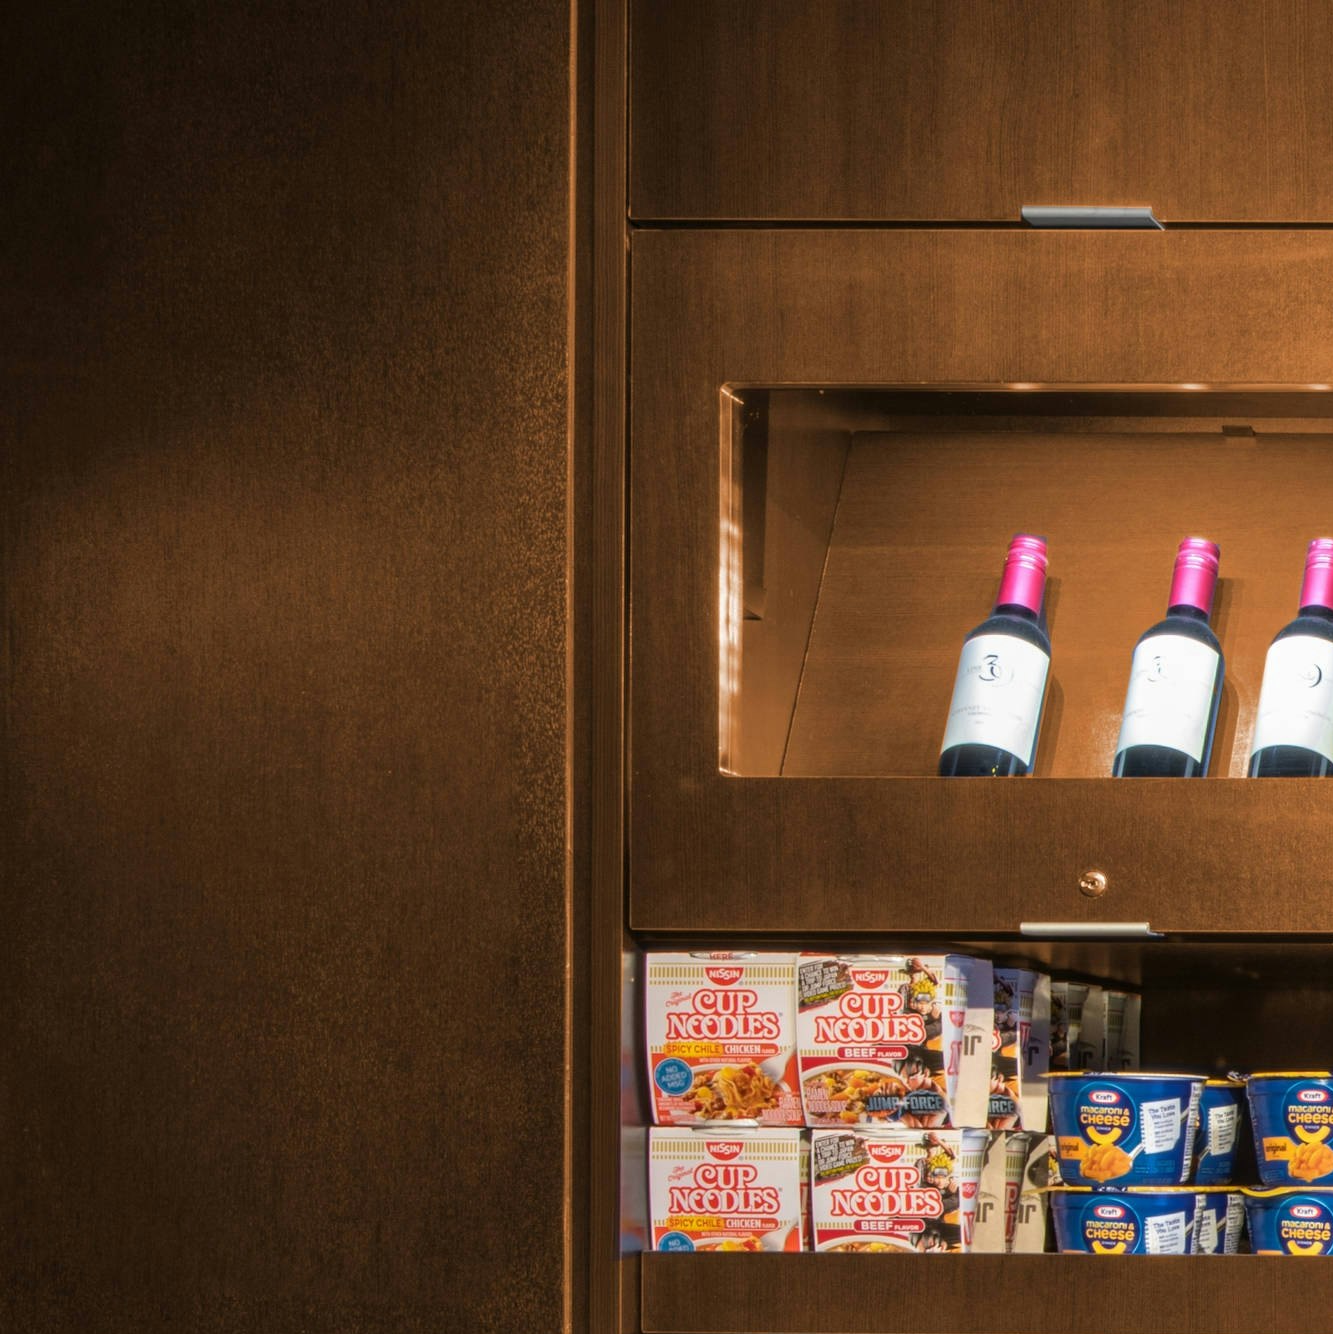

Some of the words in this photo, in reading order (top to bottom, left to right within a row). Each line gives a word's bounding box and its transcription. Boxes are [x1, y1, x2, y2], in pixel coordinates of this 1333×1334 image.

[709, 968, 740, 980] NISSIN
[855, 971, 885, 983] NISSIN
[692, 988, 759, 1015] CUP
[839, 991, 903, 1018] CUP
[666, 1012, 781, 1040] NOODLES
[815, 1014, 927, 1044] NOODLES
[725, 1044, 761, 1055] CHICKEN
[844, 1048, 876, 1058] BEEF
[1095, 1093, 1113, 1102] Kraft
[1303, 1093, 1322, 1101] Kraft
[1080, 1105, 1123, 1115] macaroni
[1288, 1104, 1331, 1114] macaroni
[709, 1144, 740, 1154] NISSIN
[871, 1146, 902, 1157] NISSIN
[693, 1163, 758, 1189] CUP
[855, 1166, 920, 1191] CUP
[669, 1187, 781, 1214] NOODLES
[831, 1189, 943, 1217] NOODLES
[726, 1219, 761, 1228] CHICKEN
[860, 1221, 893, 1231] BEEF
